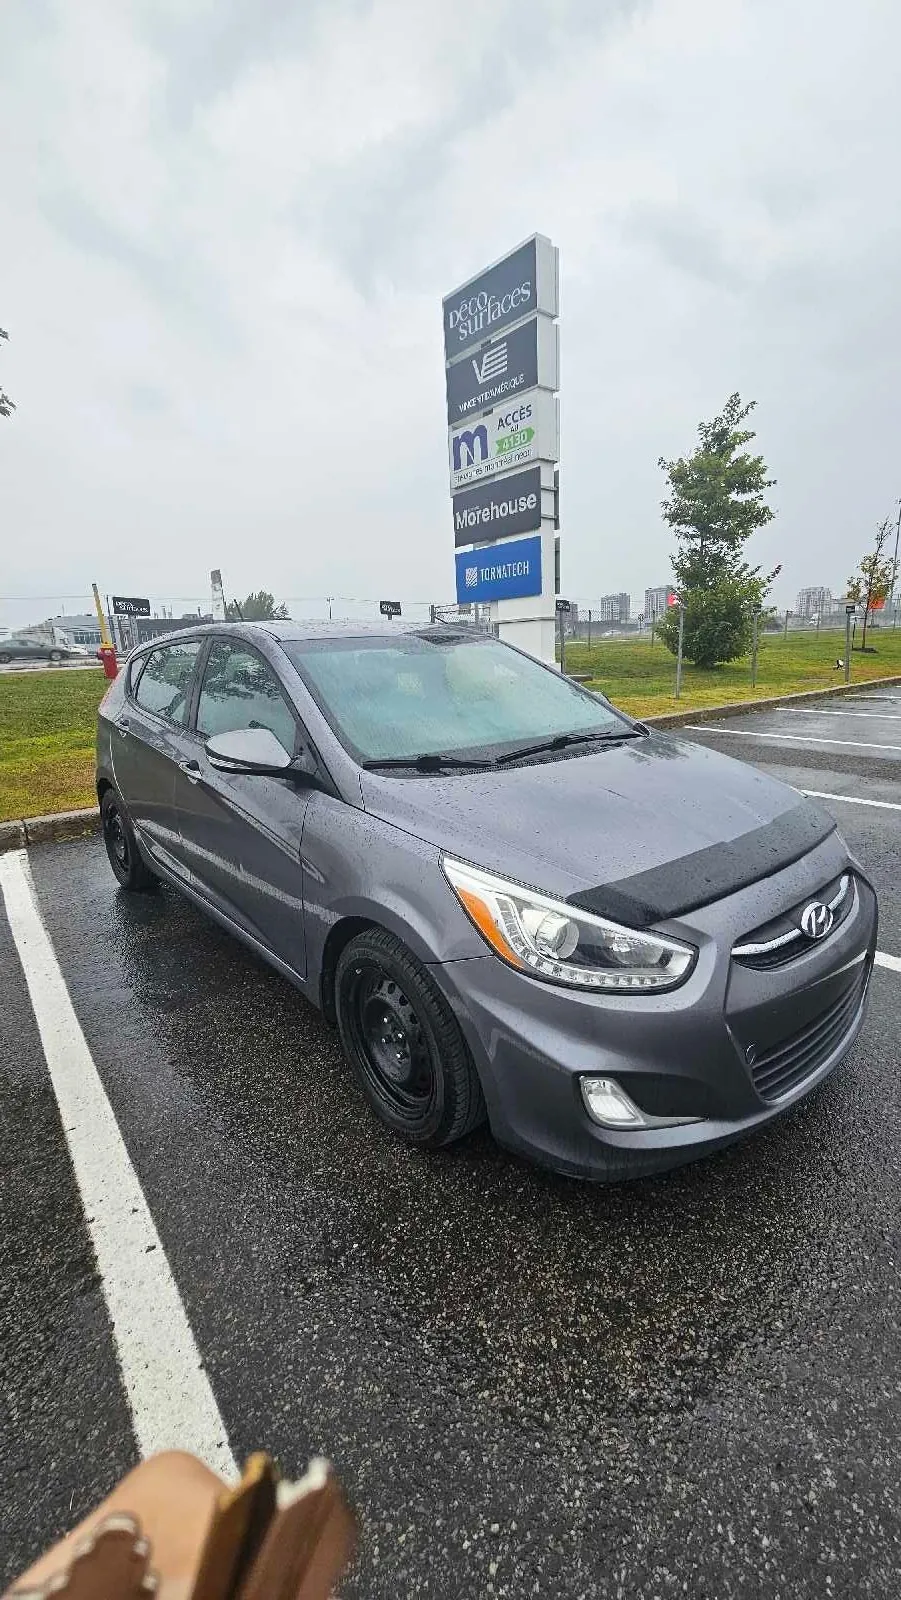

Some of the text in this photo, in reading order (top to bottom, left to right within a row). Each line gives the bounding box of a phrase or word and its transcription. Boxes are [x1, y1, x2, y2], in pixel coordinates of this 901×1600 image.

[459, 281, 531, 341] surfaces
[497, 404, 532, 430] ACCÈS
[502, 431, 528, 450] 4130
[456, 493, 537, 530] Morehouse
[479, 560, 529, 582] TORNATECH
